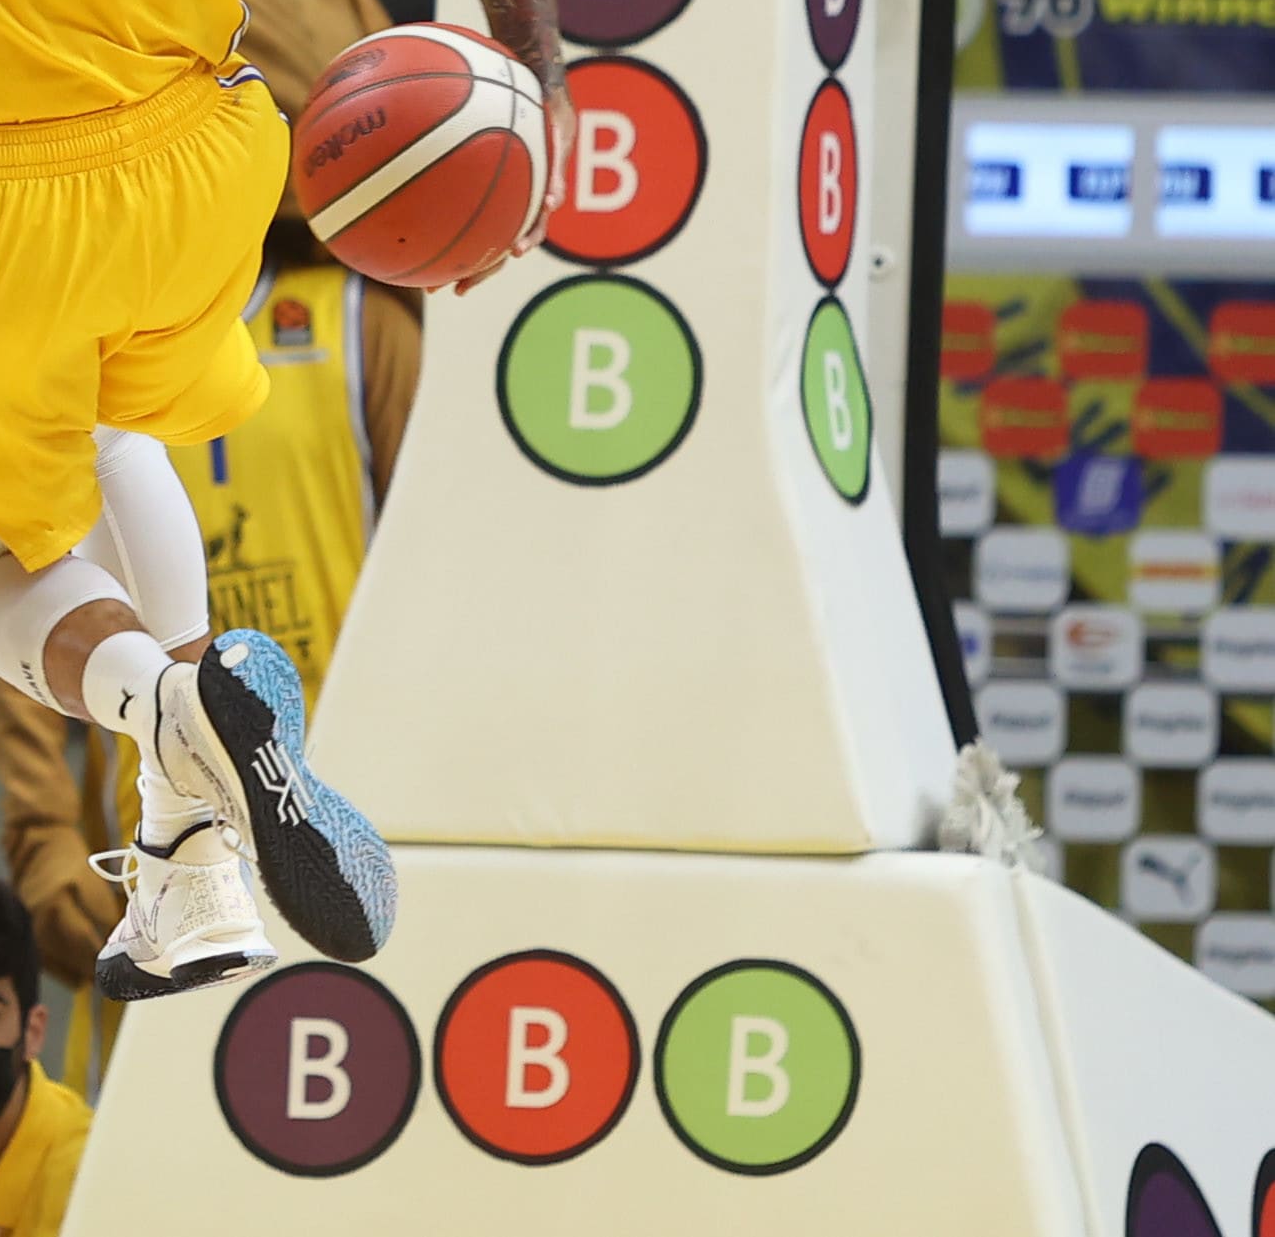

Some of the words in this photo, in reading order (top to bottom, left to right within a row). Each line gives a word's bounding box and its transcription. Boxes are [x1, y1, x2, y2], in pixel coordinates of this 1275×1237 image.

[575, 109, 639, 213] B
[819, 132, 843, 235] B
[569, 327, 633, 430] B
[824, 349, 853, 452] B
[286, 1018, 352, 1121] B
[505, 1006, 570, 1109] B
[727, 1016, 791, 1118] B
